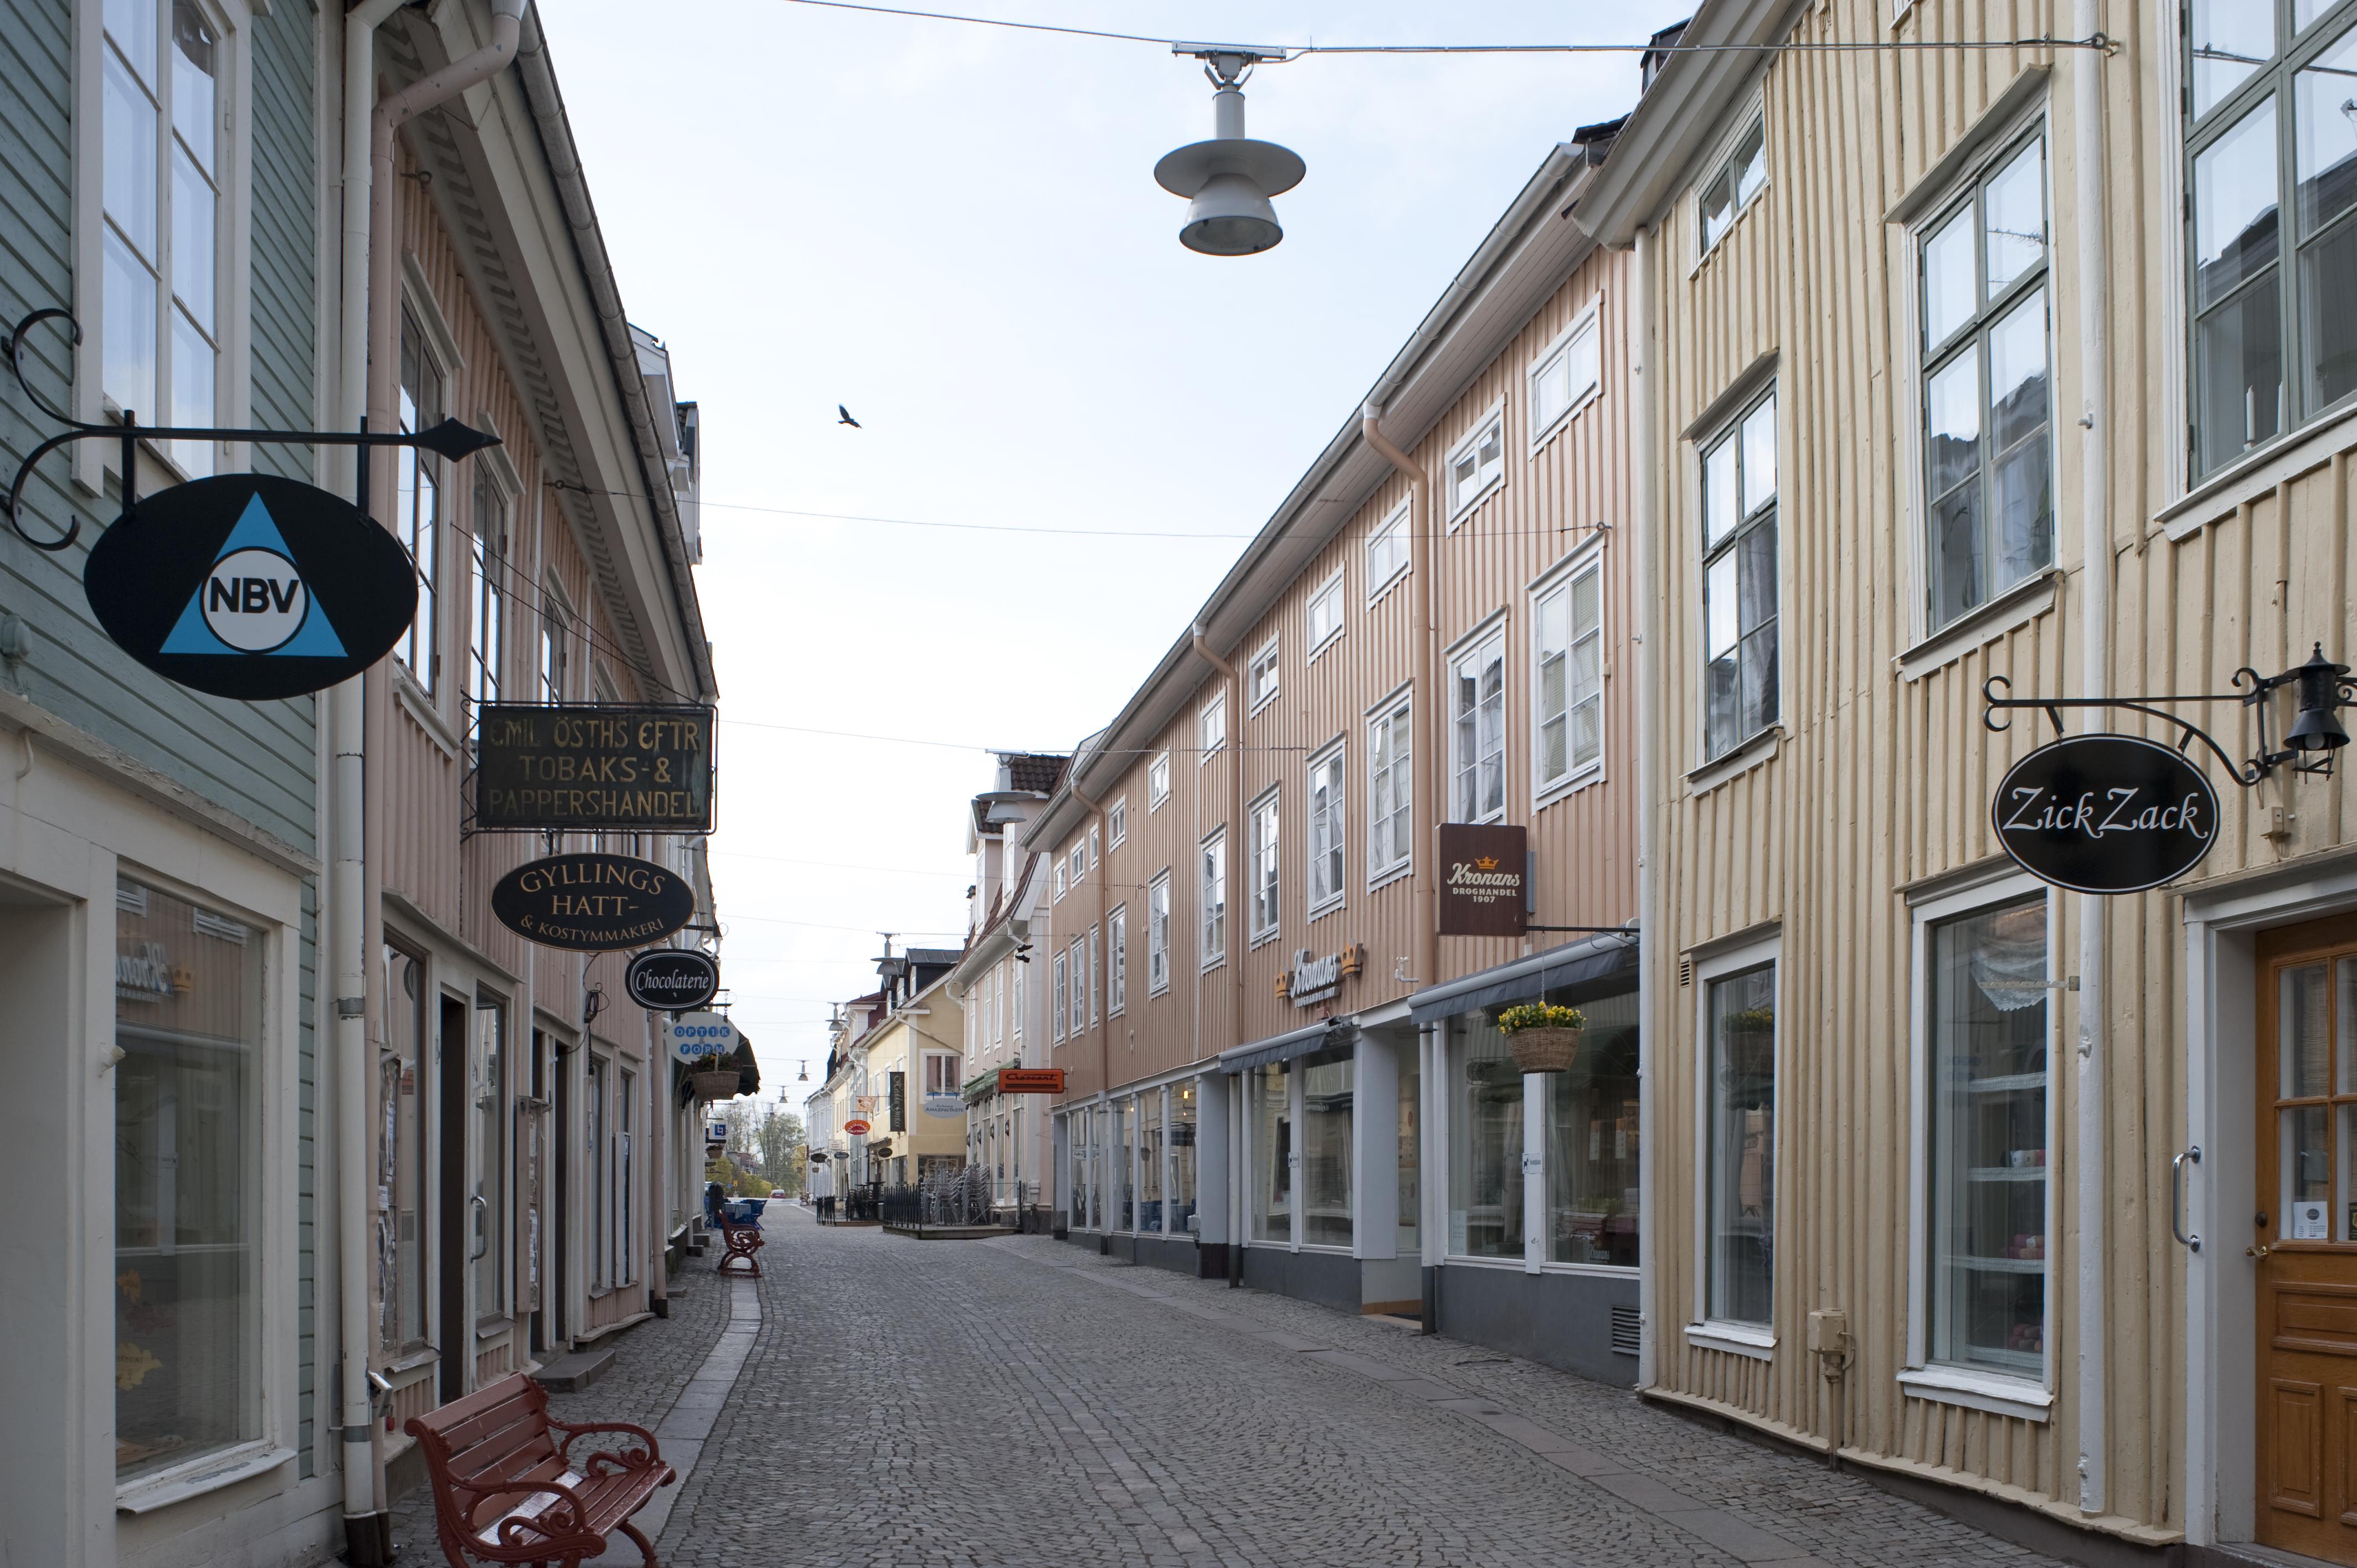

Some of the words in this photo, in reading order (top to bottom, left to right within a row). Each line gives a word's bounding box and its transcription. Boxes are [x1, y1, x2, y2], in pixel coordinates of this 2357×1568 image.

[209, 576, 300, 614] NBV
[554, 716, 629, 749] ÖSTHS
[639, 721, 699, 751] EFTR
[654, 757, 672, 783] &
[489, 789, 701, 818] PAPPERSHANDEL
[520, 863, 666, 895] GYLLINGS
[1447, 863, 1520, 886] Kronans
[1453, 888, 1517, 896] DROGHANDEL
[552, 895, 639, 916] HATT-
[521, 915, 533, 930] &
[538, 918, 665, 942] KOSTYMMAKERI
[636, 969, 709, 991] Chocolaterie
[1290, 948, 1337, 999] Kronans
[1294, 991, 1324, 1008] DROGHANDEL
[675, 1027, 730, 1036] OPTIK
[681, 1044, 724, 1054] FORM
